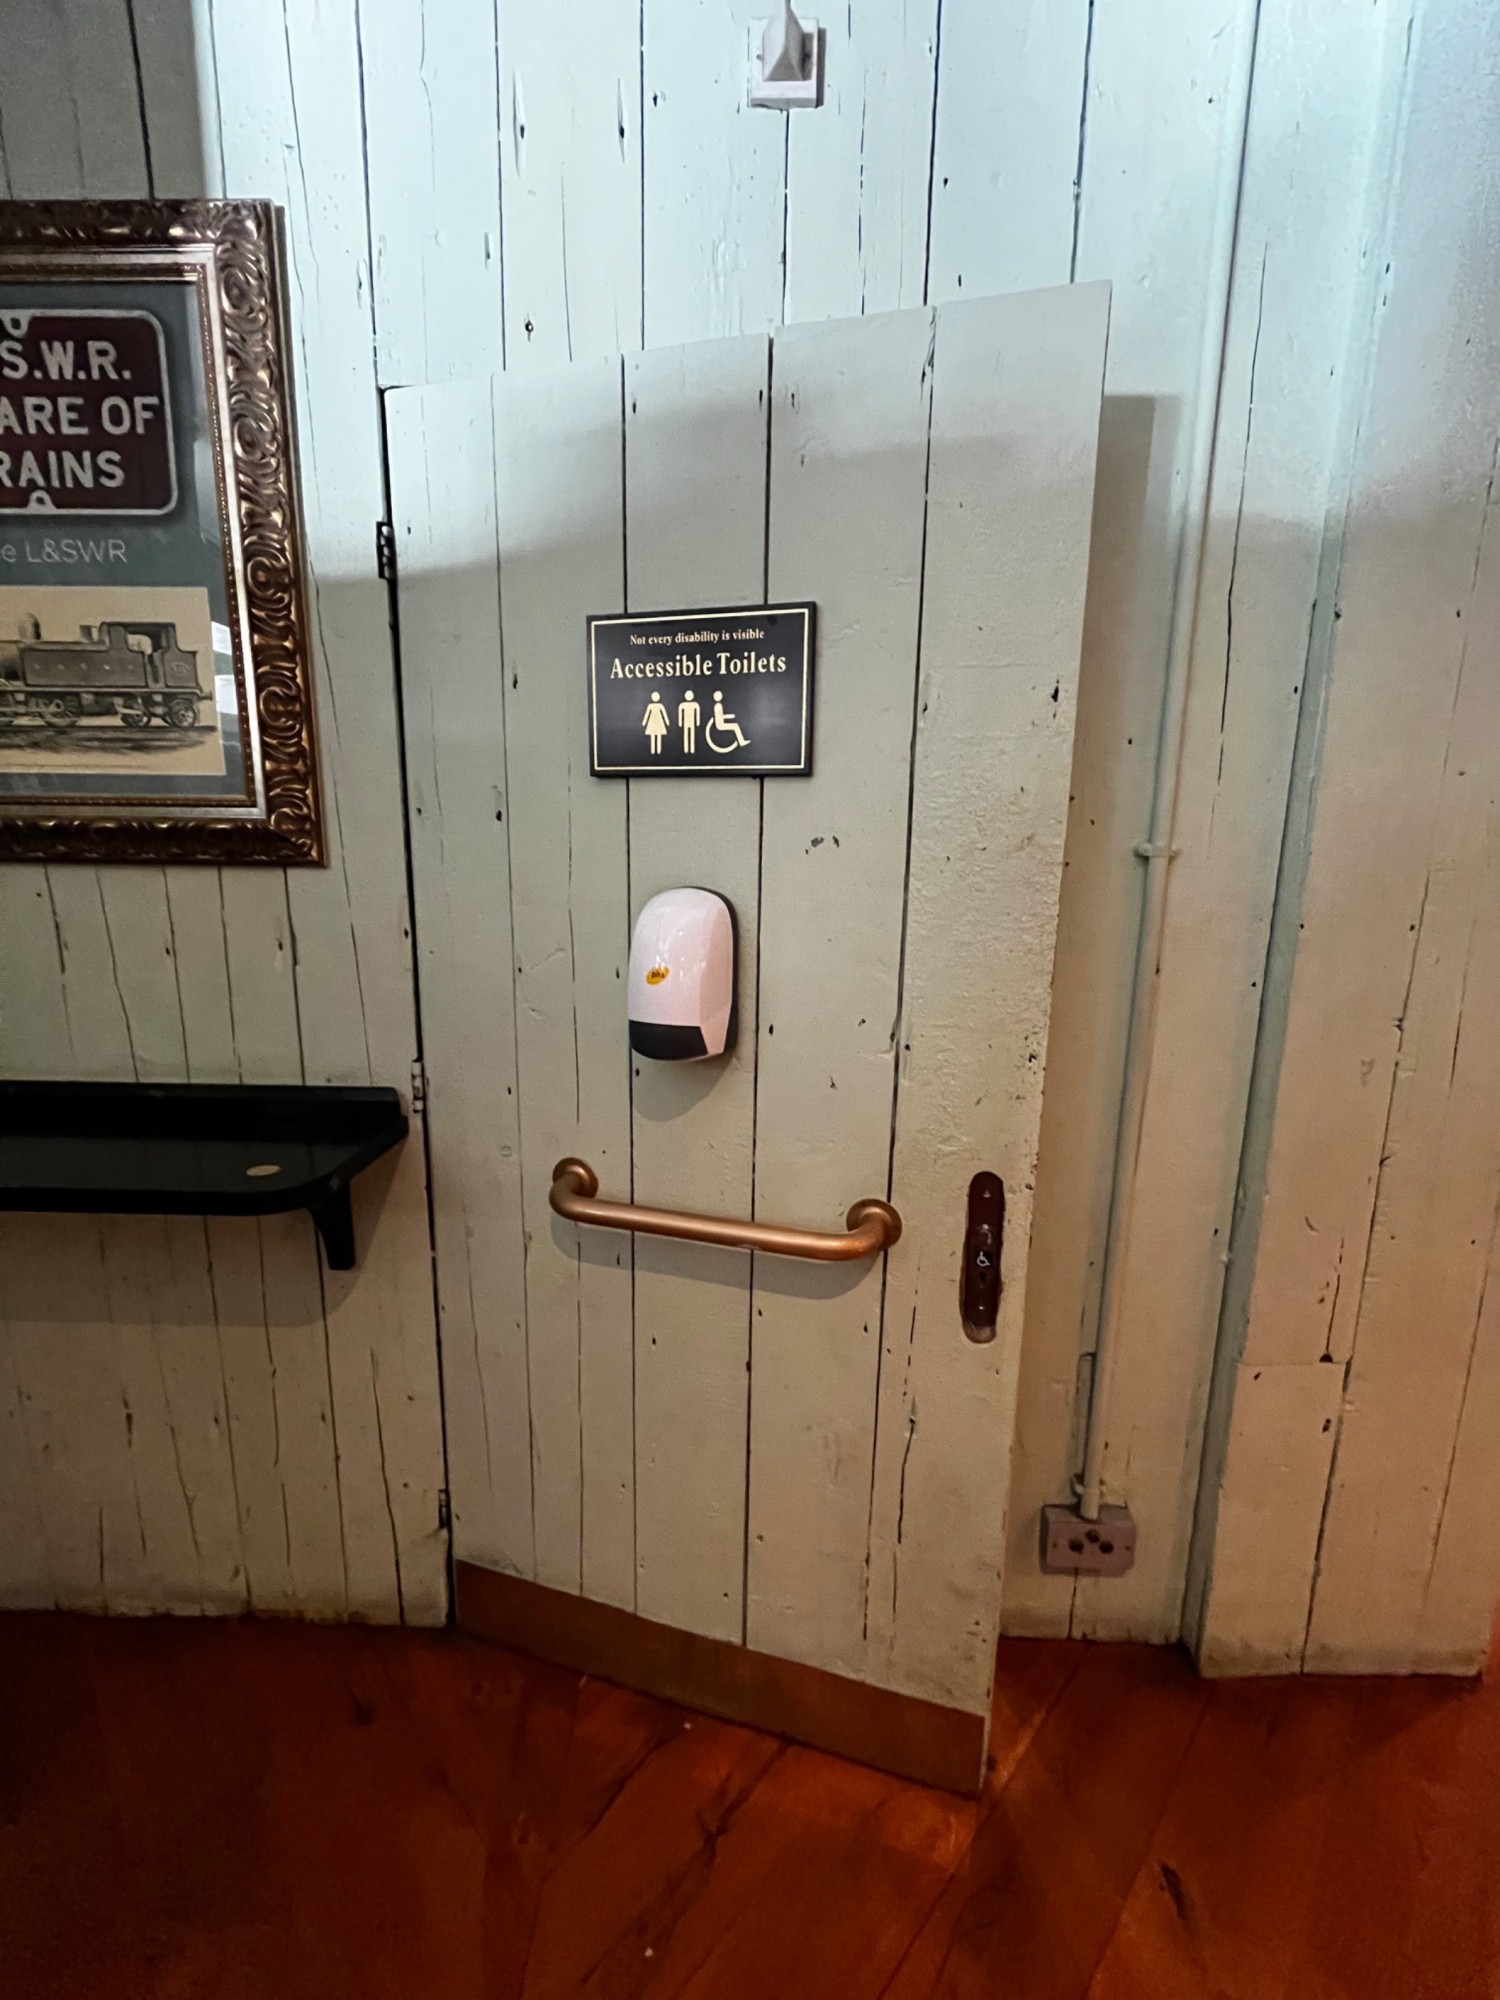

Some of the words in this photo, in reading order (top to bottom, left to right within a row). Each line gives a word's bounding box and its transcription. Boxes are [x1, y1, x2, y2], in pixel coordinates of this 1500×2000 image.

[0, 396, 89, 435] ARE
[101, 395, 160, 435] OF
[24, 538, 128, 564] L&SWR
[630, 634, 647, 646] Not
[648, 633, 672, 646] every
[675, 630, 719, 644] disability
[722, 630, 730, 641] is
[733, 628, 765, 640] visible
[610, 653, 713, 679] Accessible
[717, 651, 787, 675] Toilets
